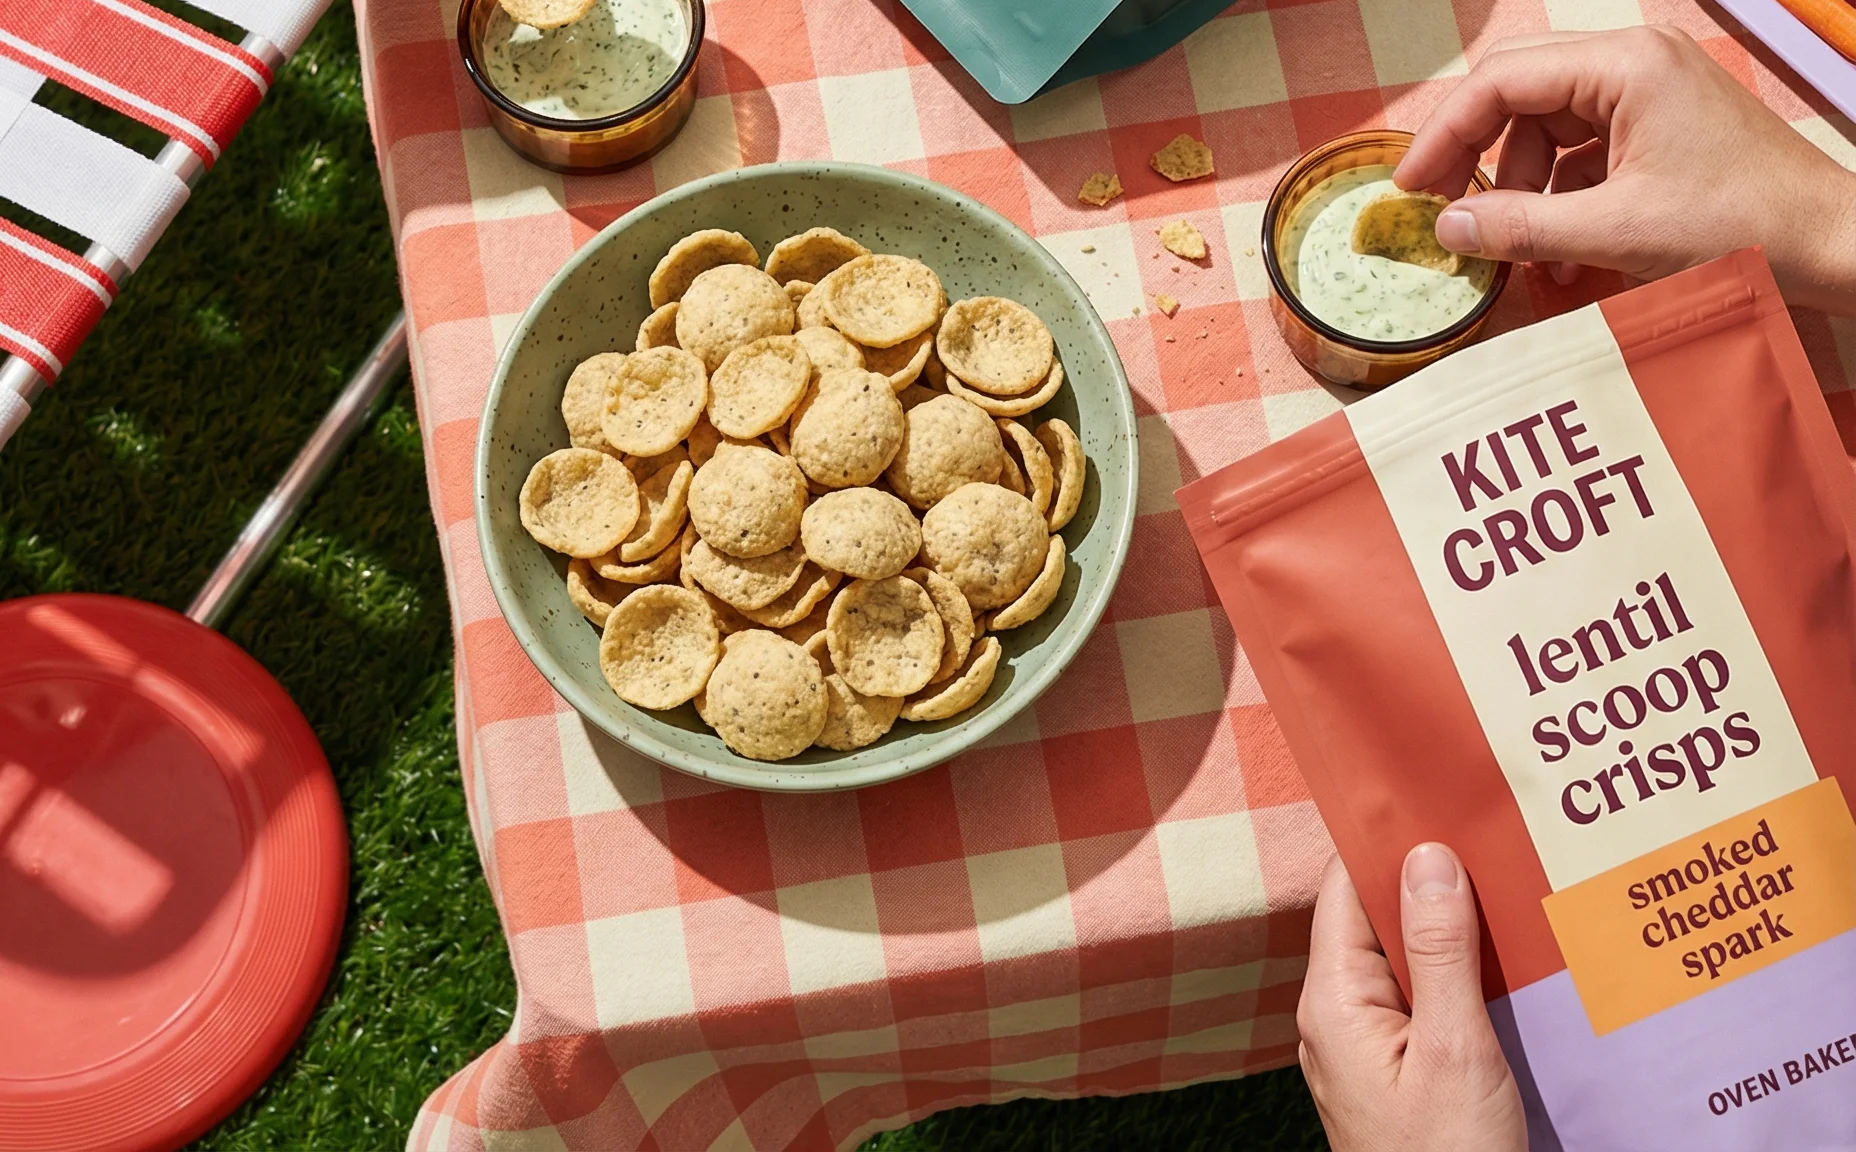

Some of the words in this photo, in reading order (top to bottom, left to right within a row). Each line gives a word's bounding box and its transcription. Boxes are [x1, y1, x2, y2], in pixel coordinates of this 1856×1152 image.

[1441, 400, 1601, 513] KITE
[1442, 454, 1656, 592] CROFT
[1507, 572, 1694, 695] lentil
[1532, 647, 1731, 763] scoop
[1560, 710, 1761, 825] crisps
[1627, 818, 1779, 910] smoked
[1642, 864, 1795, 948] cheddar
[1681, 908, 1793, 980] spark
[1708, 1068, 1780, 1115] OVEN
